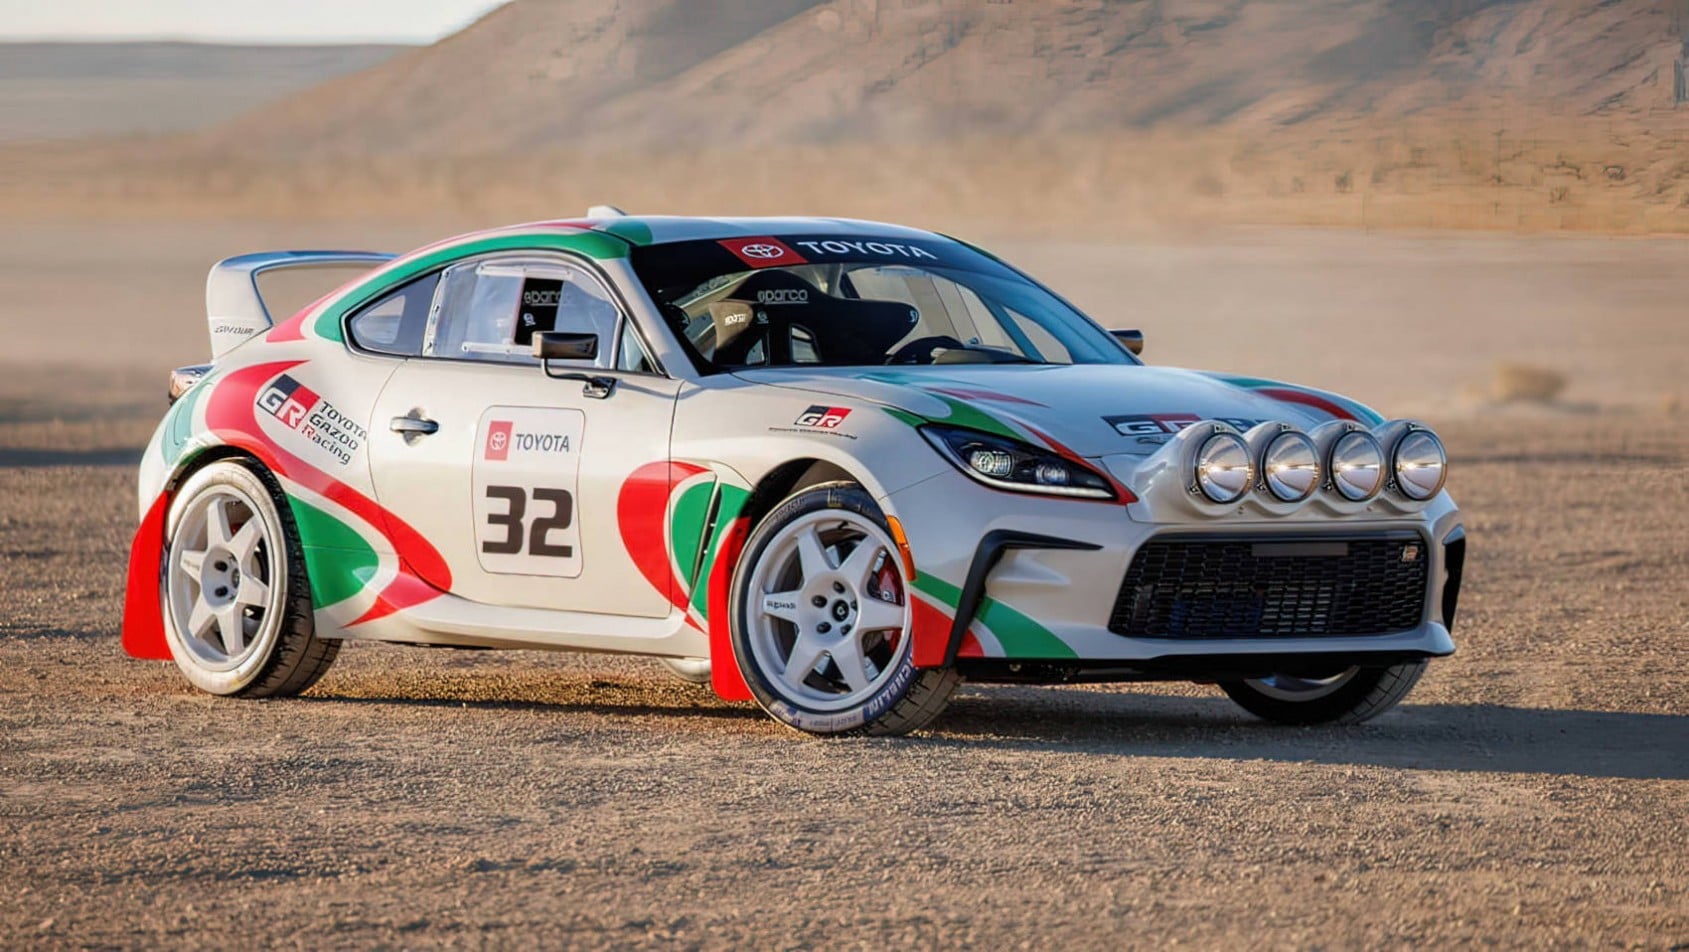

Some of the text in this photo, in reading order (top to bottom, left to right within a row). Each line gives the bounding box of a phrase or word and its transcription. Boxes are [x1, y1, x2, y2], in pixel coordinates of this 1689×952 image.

[797, 240, 939, 261] TOYOTA
[259, 386, 308, 429] GR
[320, 400, 367, 441] TOYOTA
[794, 412, 843, 429] GR
[301, 424, 351, 466] Racing
[309, 413, 359, 451] GAZOO
[516, 433, 570, 453] TOYOTA
[482, 485, 573, 558] 32
